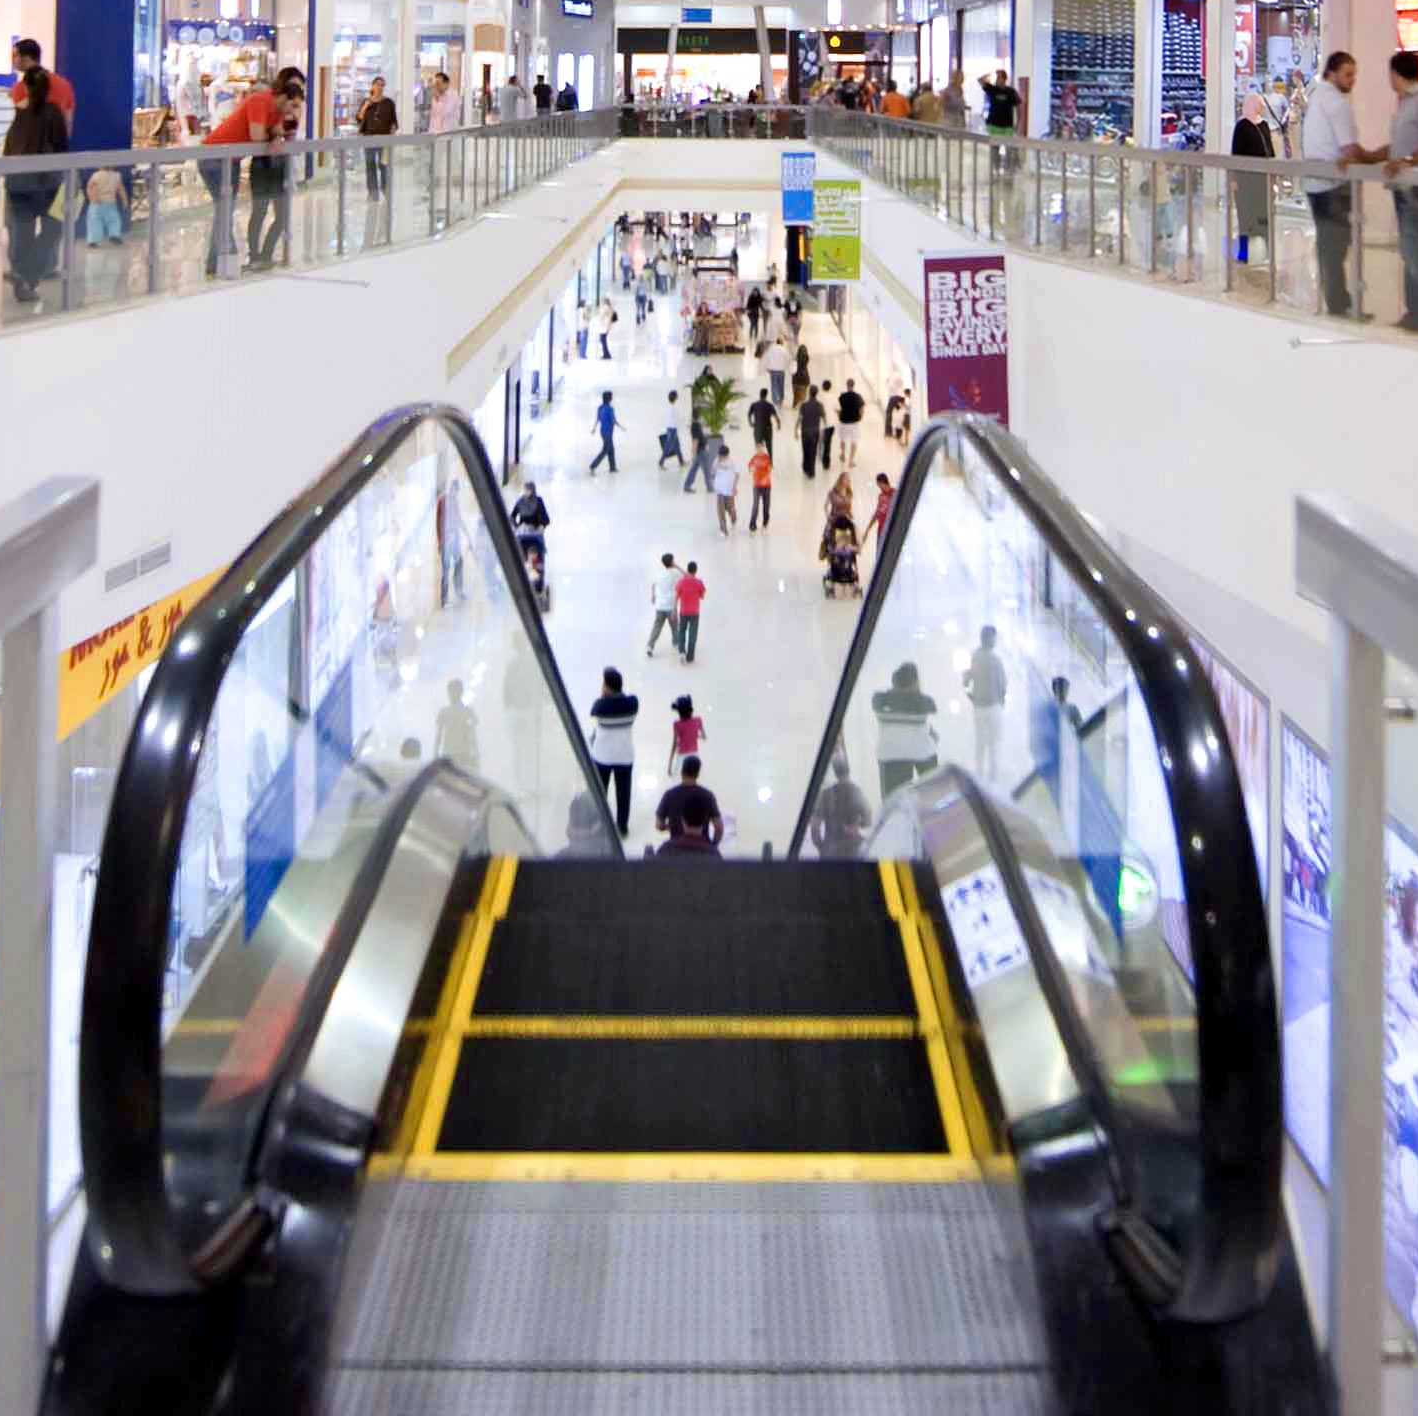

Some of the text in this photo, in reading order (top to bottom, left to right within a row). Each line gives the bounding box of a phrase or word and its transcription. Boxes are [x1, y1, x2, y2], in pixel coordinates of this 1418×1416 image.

[928, 269, 1006, 289] BIG
[930, 299, 1006, 318] BIG
[930, 328, 1006, 346] EVERY
[931, 343, 1006, 359] SINGLE DAY
[136, 614, 154, 658] &
